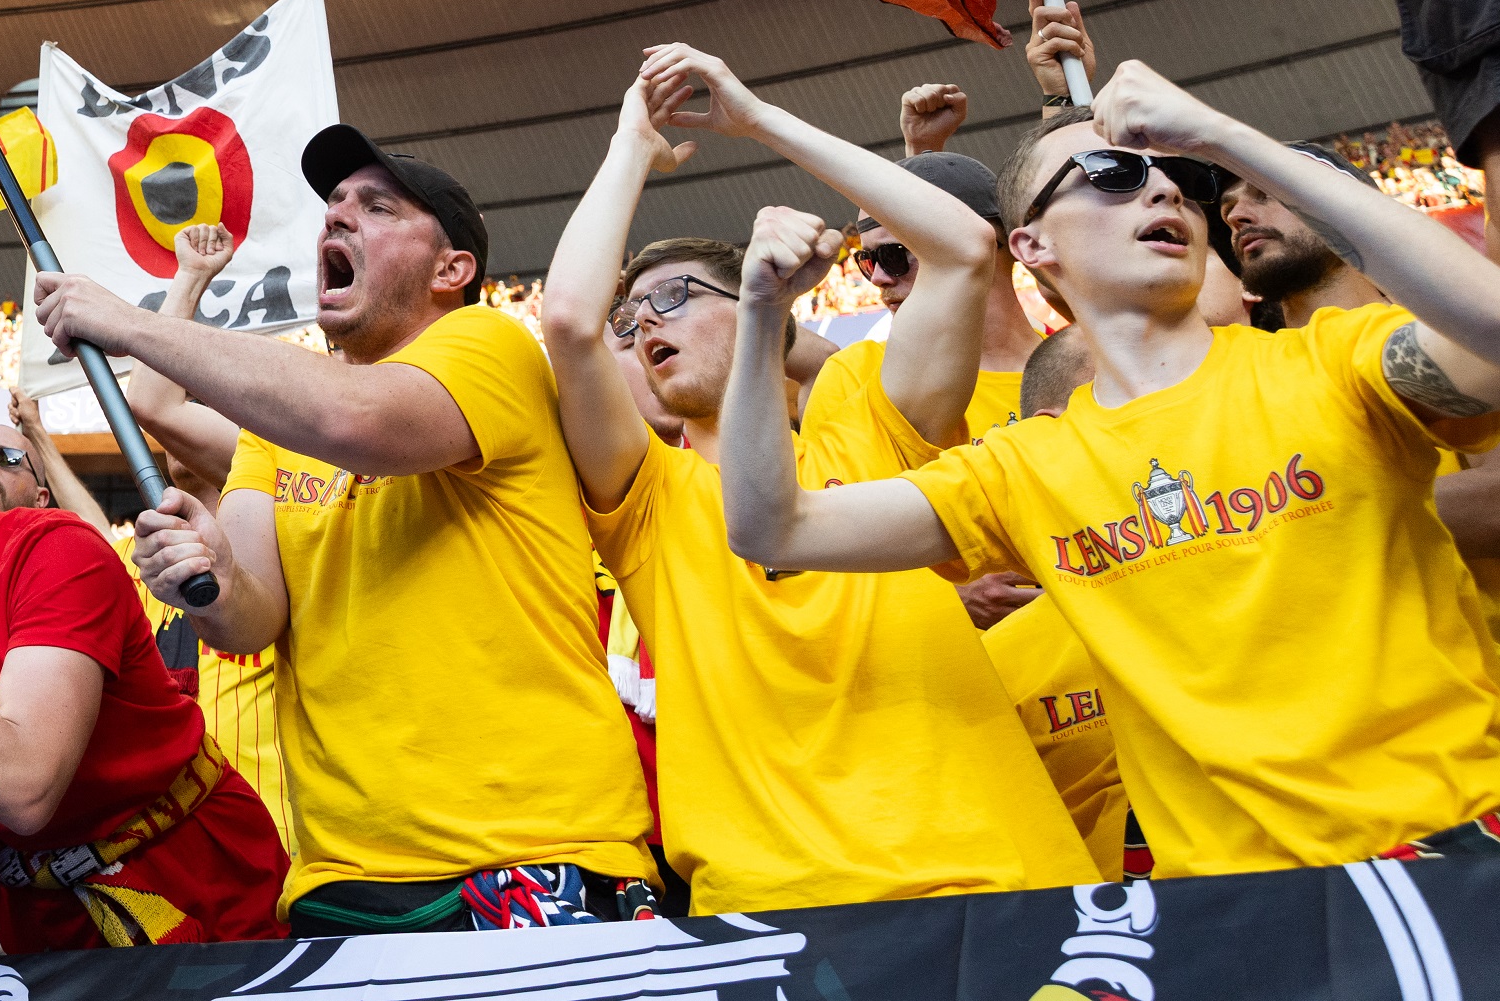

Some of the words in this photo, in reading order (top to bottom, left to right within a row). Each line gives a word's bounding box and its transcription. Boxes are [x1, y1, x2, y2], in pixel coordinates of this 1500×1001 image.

[275, 468, 326, 504] ENS
[1050, 515, 1146, 577] LENS
[1204, 453, 1325, 536] 1906
[1182, 542, 1215, 559] POUR
